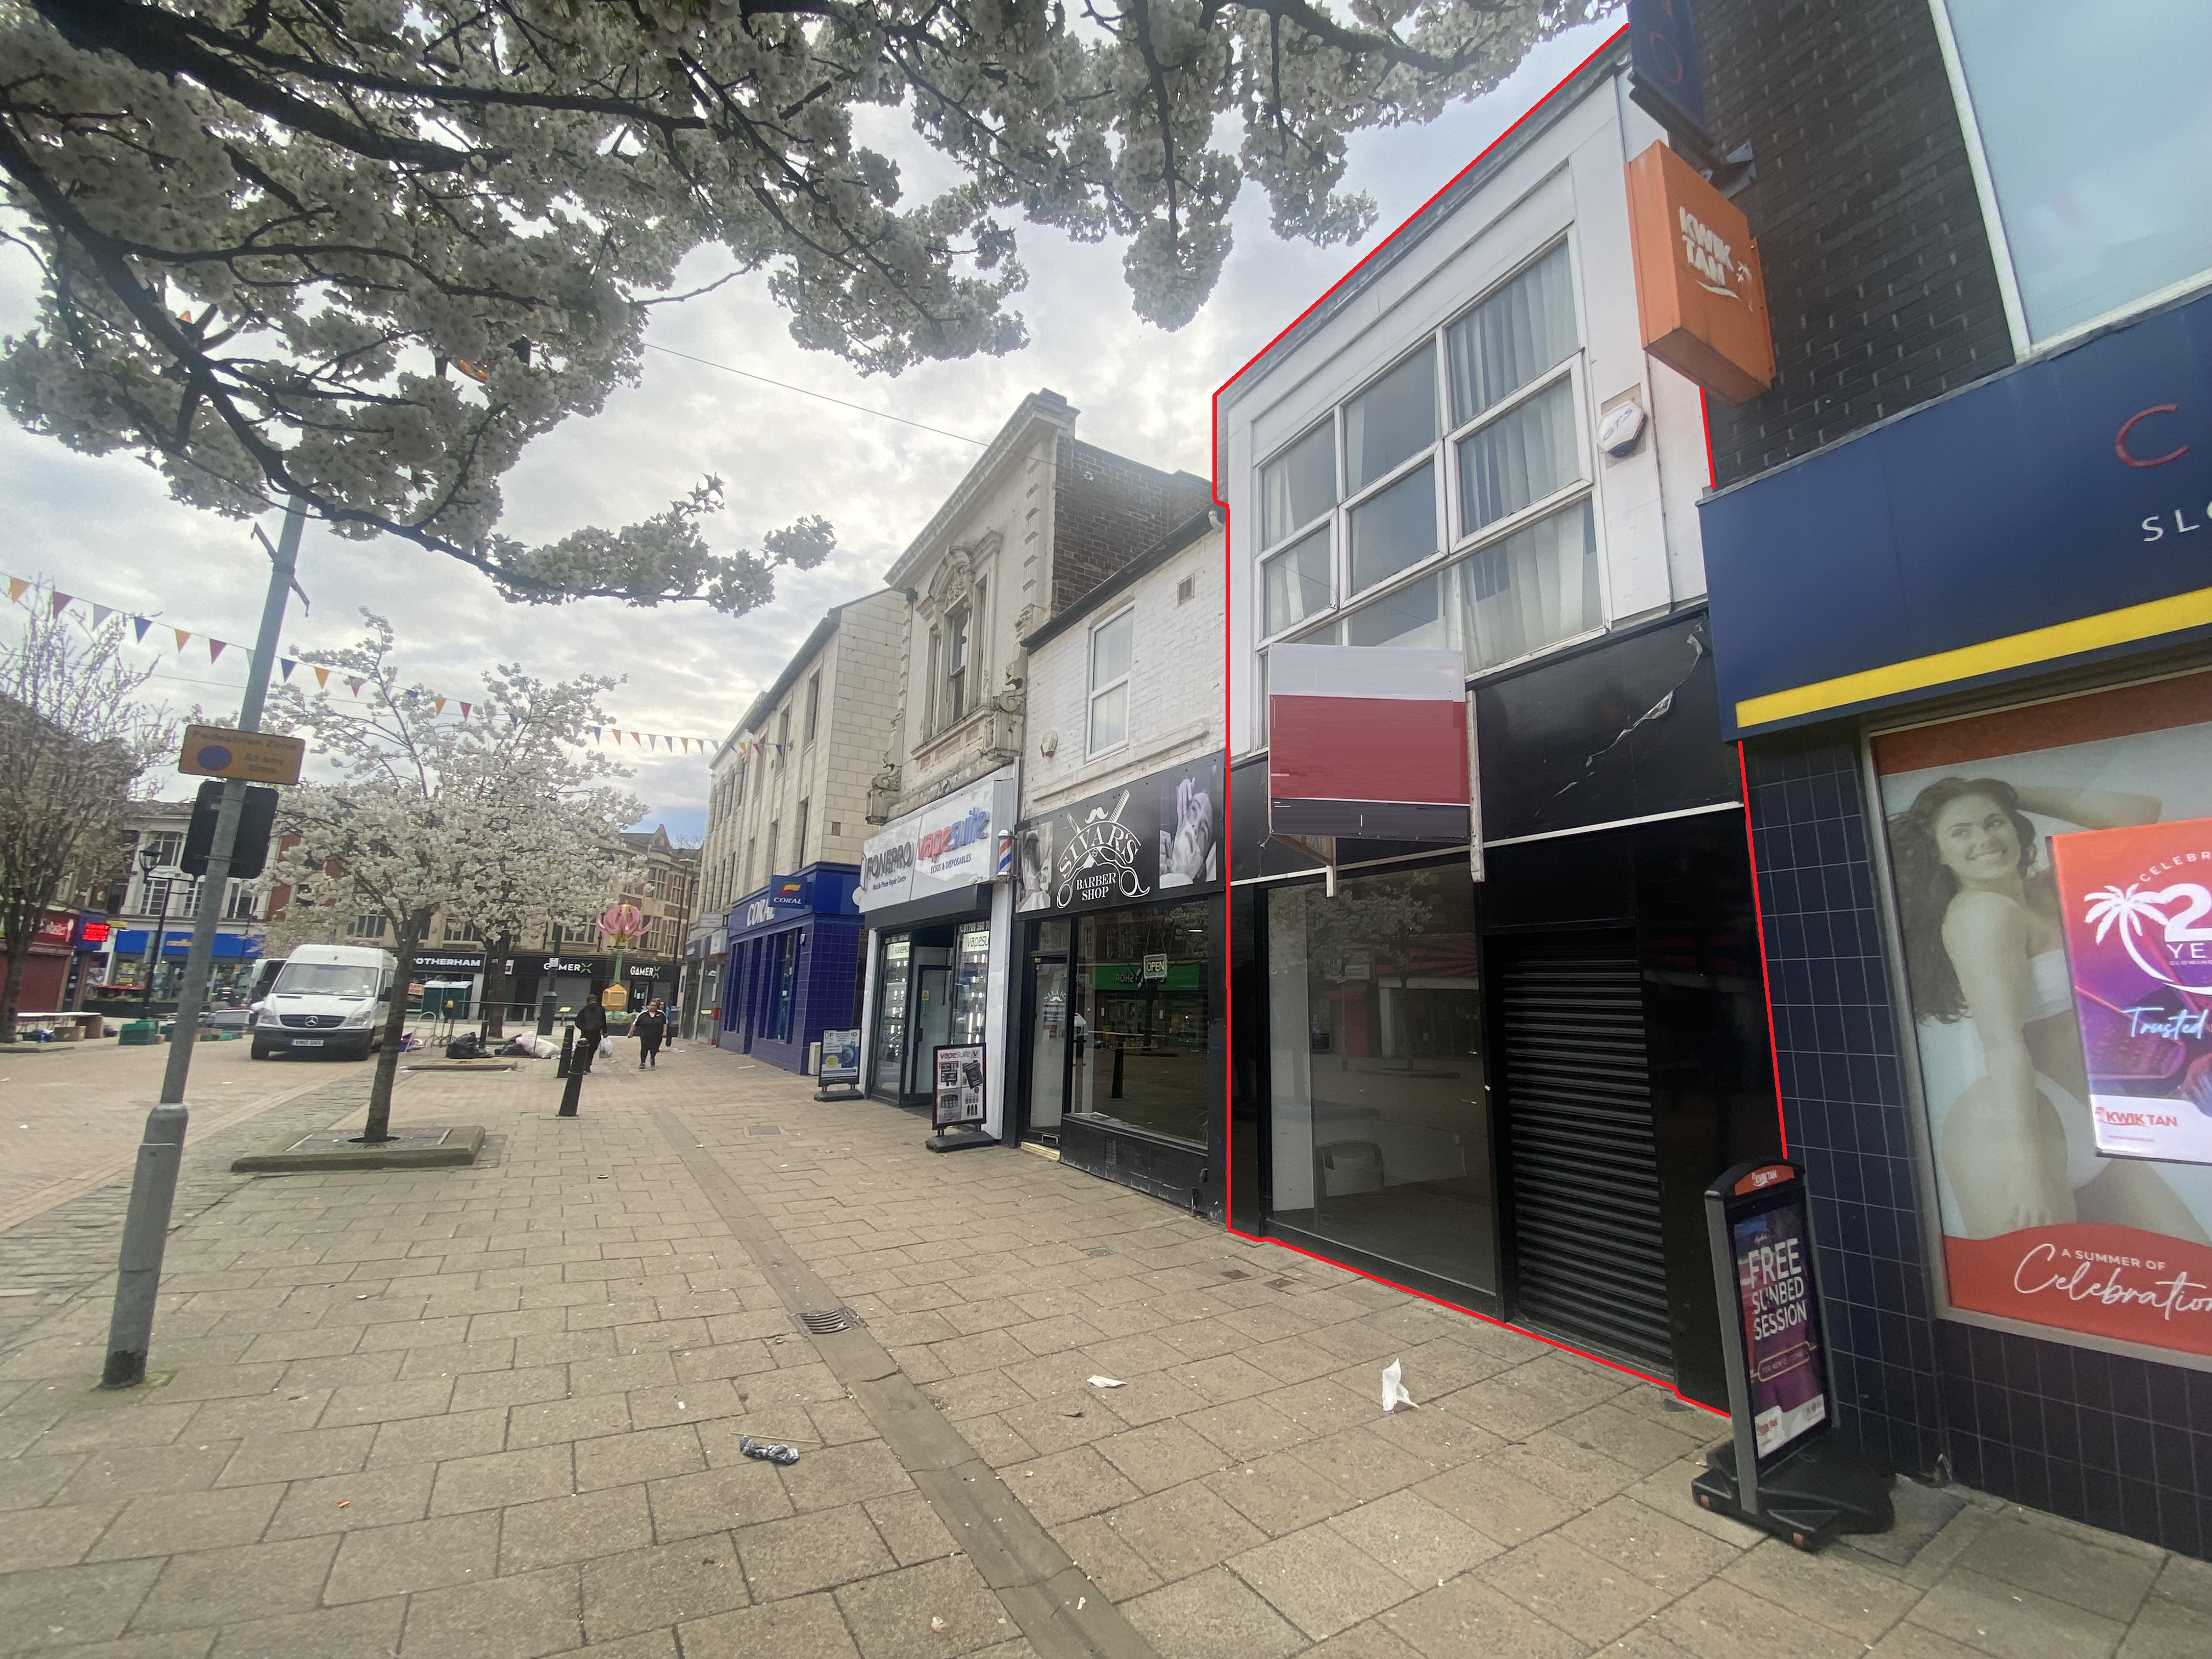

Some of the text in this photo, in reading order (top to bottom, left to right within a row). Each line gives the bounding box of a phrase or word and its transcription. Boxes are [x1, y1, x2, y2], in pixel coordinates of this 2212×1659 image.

[1680, 206, 1734, 272] KWIK
[1683, 235, 1725, 285] TAN
[2141, 500, 2212, 541] SL
[244, 753, 284, 766] At any
[249, 765, 276, 775] time
[918, 807, 990, 864] vapesuite
[867, 842, 912, 879] FONEPRO
[946, 853, 972, 869] DISPOSABLES
[1059, 824, 1139, 879] SIVAR'S
[1076, 872, 1116, 890] BARBER
[1082, 886, 1109, 901] SHOP
[414, 958, 481, 967] OTHERHAM
[544, 962, 592, 974] GMERX
[630, 965, 661, 979] GAMERX
[1147, 961, 1164, 972] OPEN
[2122, 1007, 2209, 1040] Trusted
[2106, 1111, 2177, 1127] KWIK TAN
[1748, 1238, 1802, 1289] FREE
[2061, 1249, 2166, 1271] A SUMMER OF
[1752, 1277, 1804, 1314] SUNBED
[1753, 1299, 1807, 1341] SESSION
